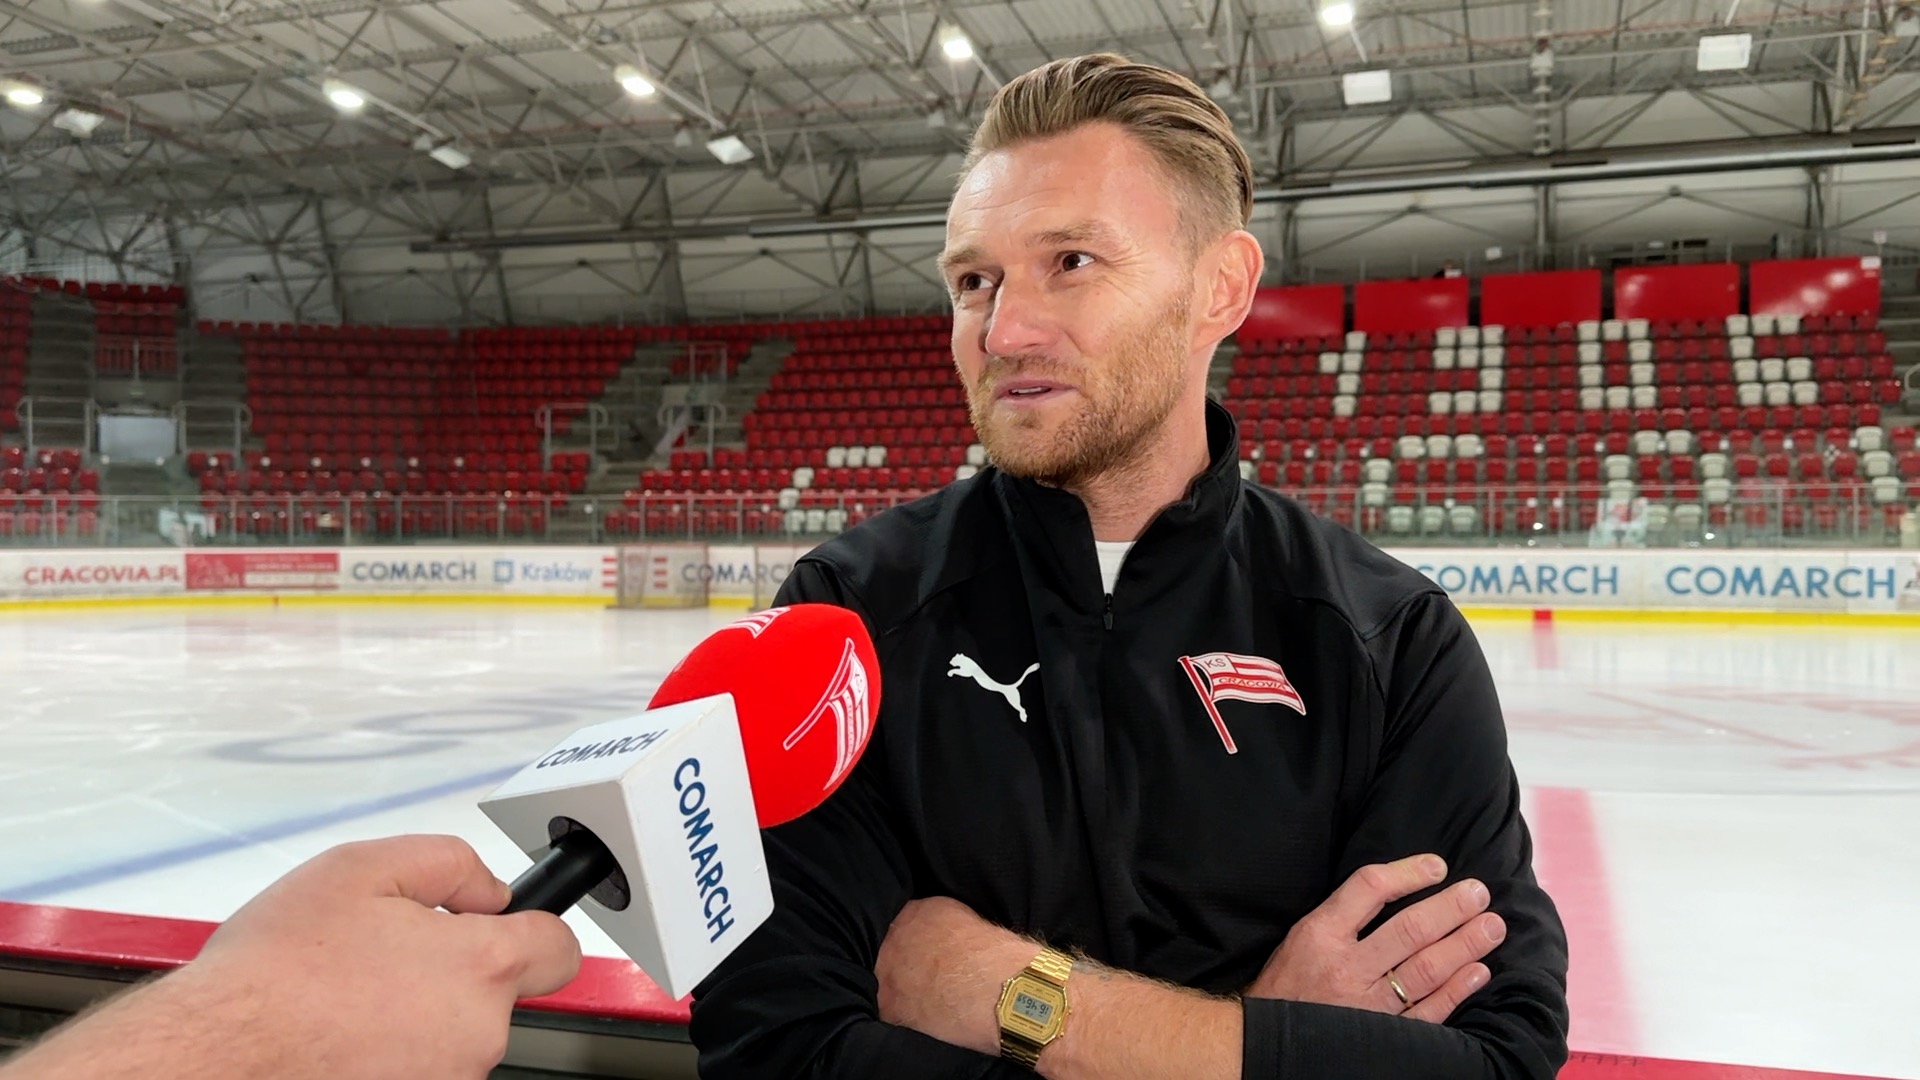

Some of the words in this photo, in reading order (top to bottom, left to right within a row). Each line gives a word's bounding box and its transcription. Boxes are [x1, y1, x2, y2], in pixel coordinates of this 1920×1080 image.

[23, 563, 181, 585] CRACOVIA.PL
[352, 561, 477, 582] COMARCH
[521, 561, 593, 582] Kraków
[681, 563, 793, 584] COMARC
[1666, 566, 1895, 599] COMARCH
[1204, 658, 1227, 669] KS
[1218, 677, 1286, 690] CRACOVIA
[535, 729, 669, 769] COMARCH
[673, 757, 736, 944] COMARCH
